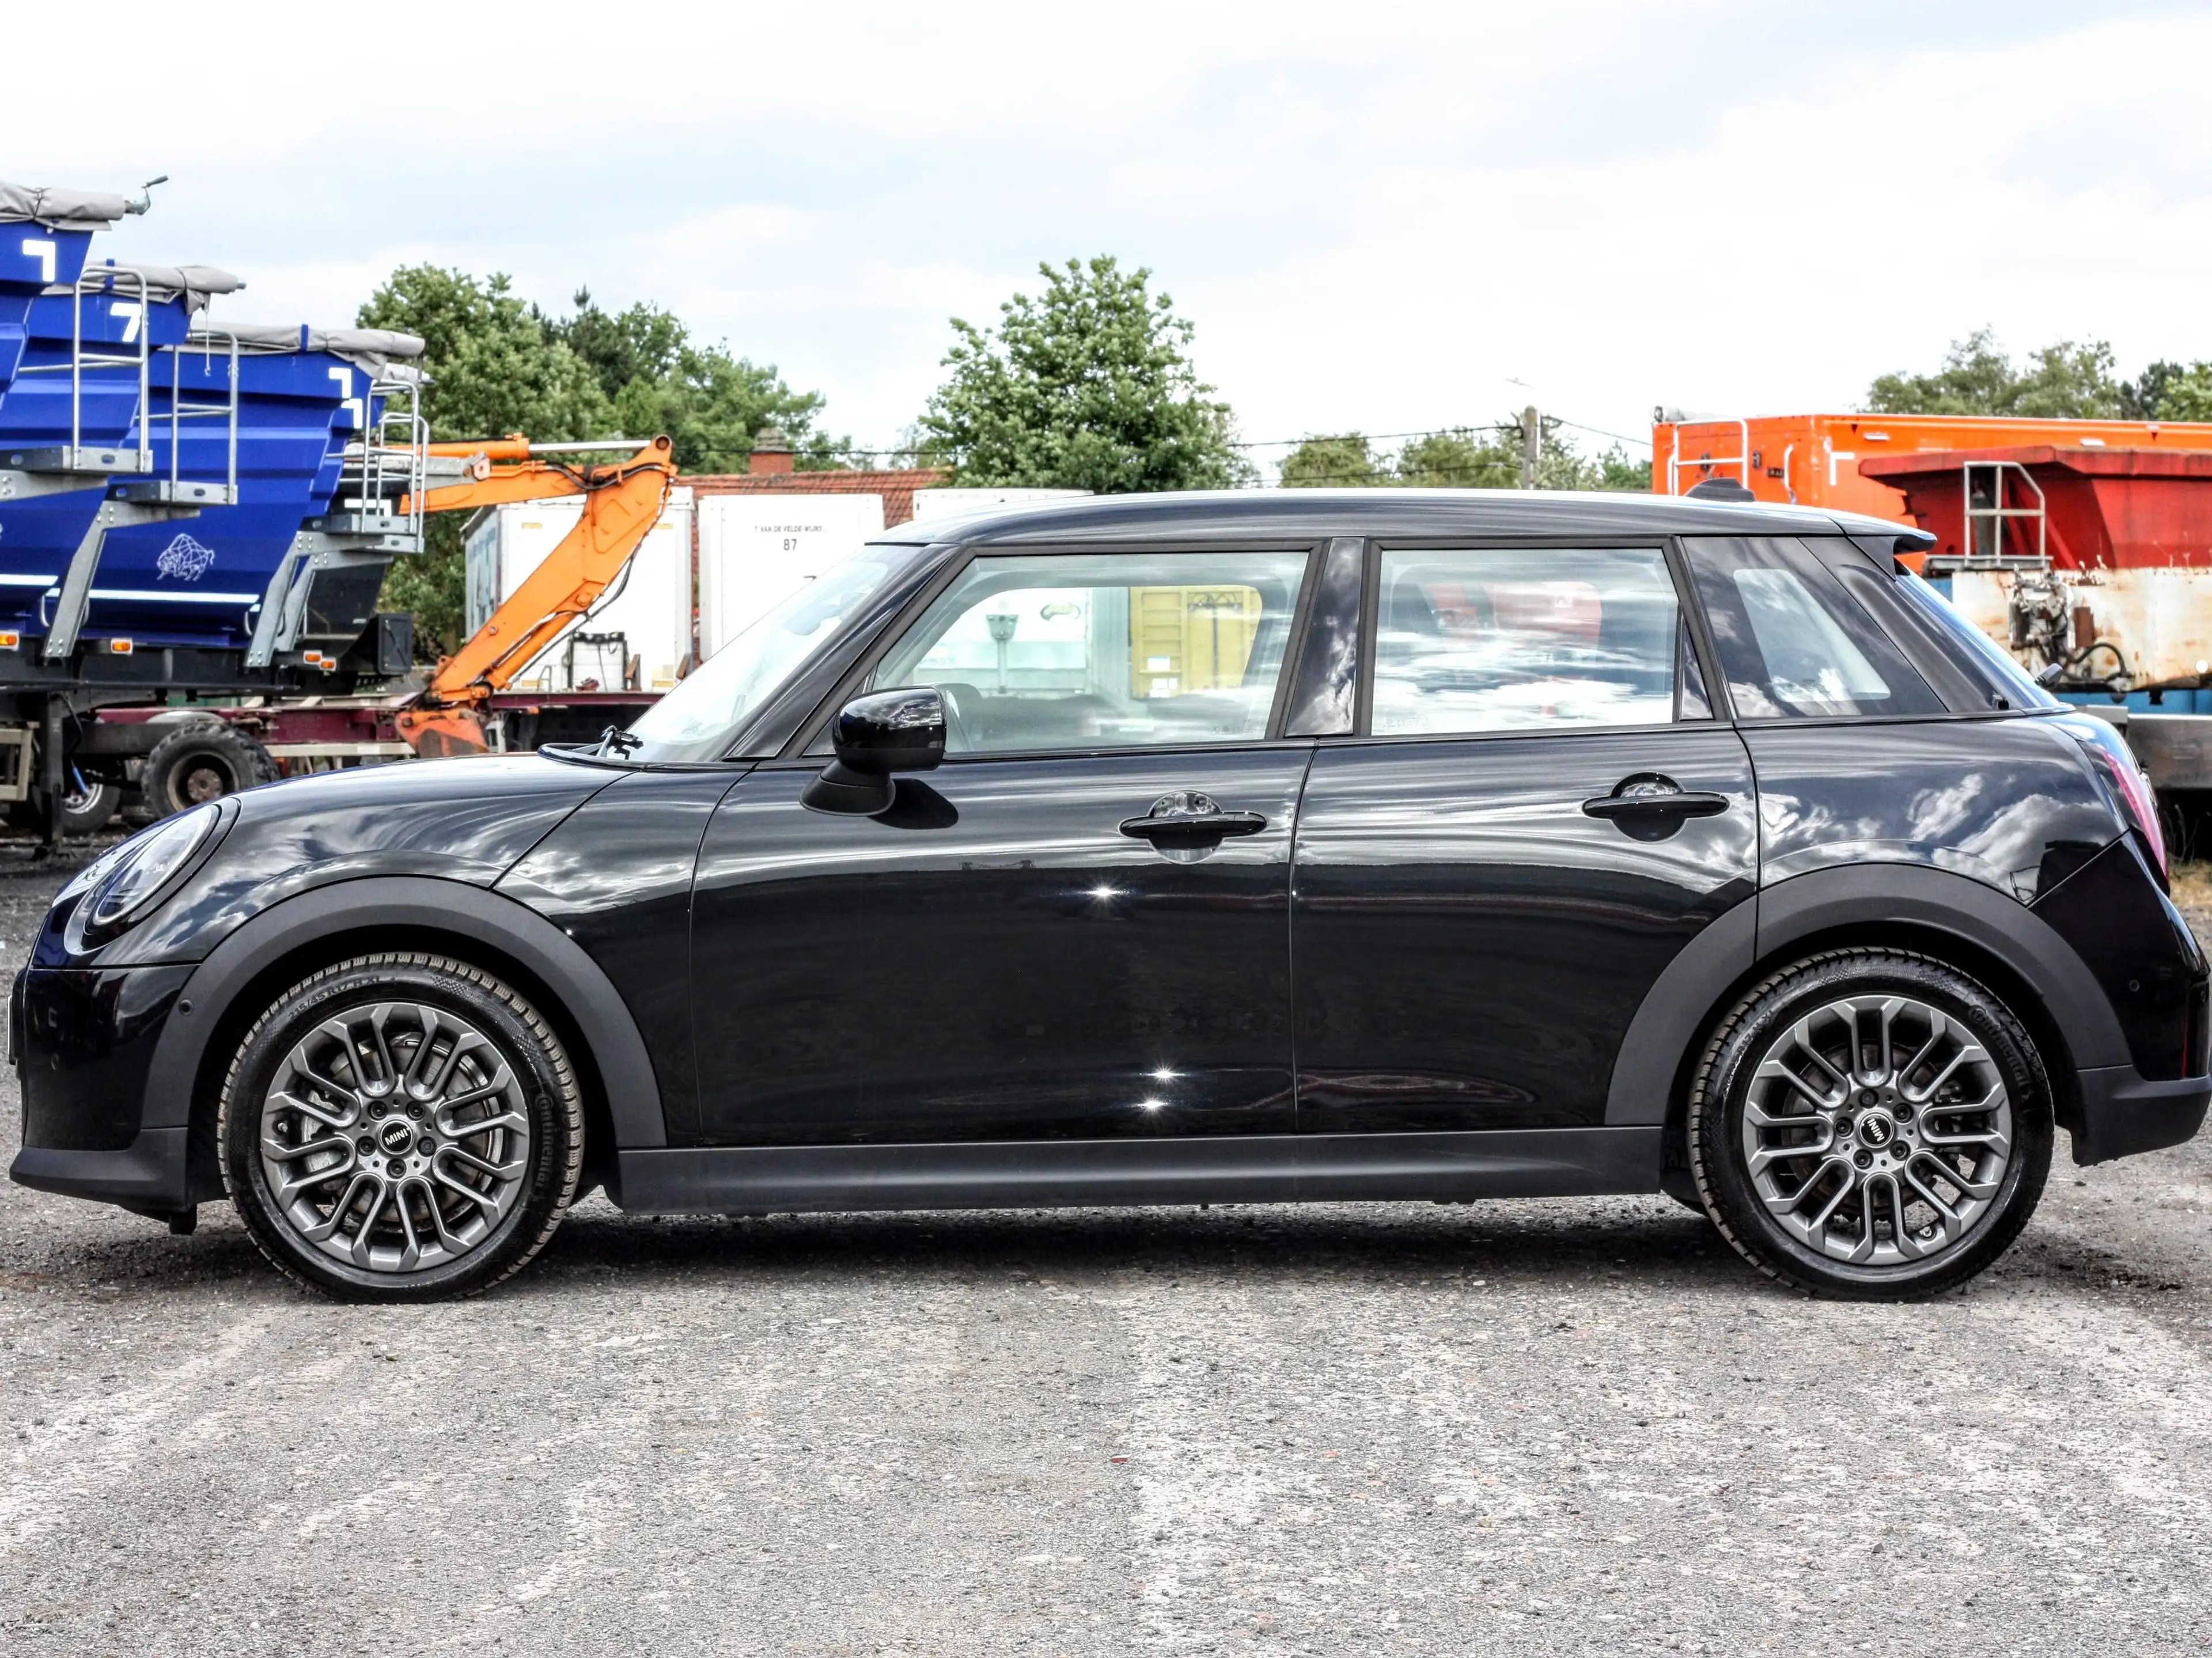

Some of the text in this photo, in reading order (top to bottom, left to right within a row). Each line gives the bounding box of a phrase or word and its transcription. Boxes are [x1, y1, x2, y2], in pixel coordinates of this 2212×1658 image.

[783, 538, 797, 551] 87
[384, 1128, 408, 1145] MINI
[1867, 1118, 1885, 1142] MINI
